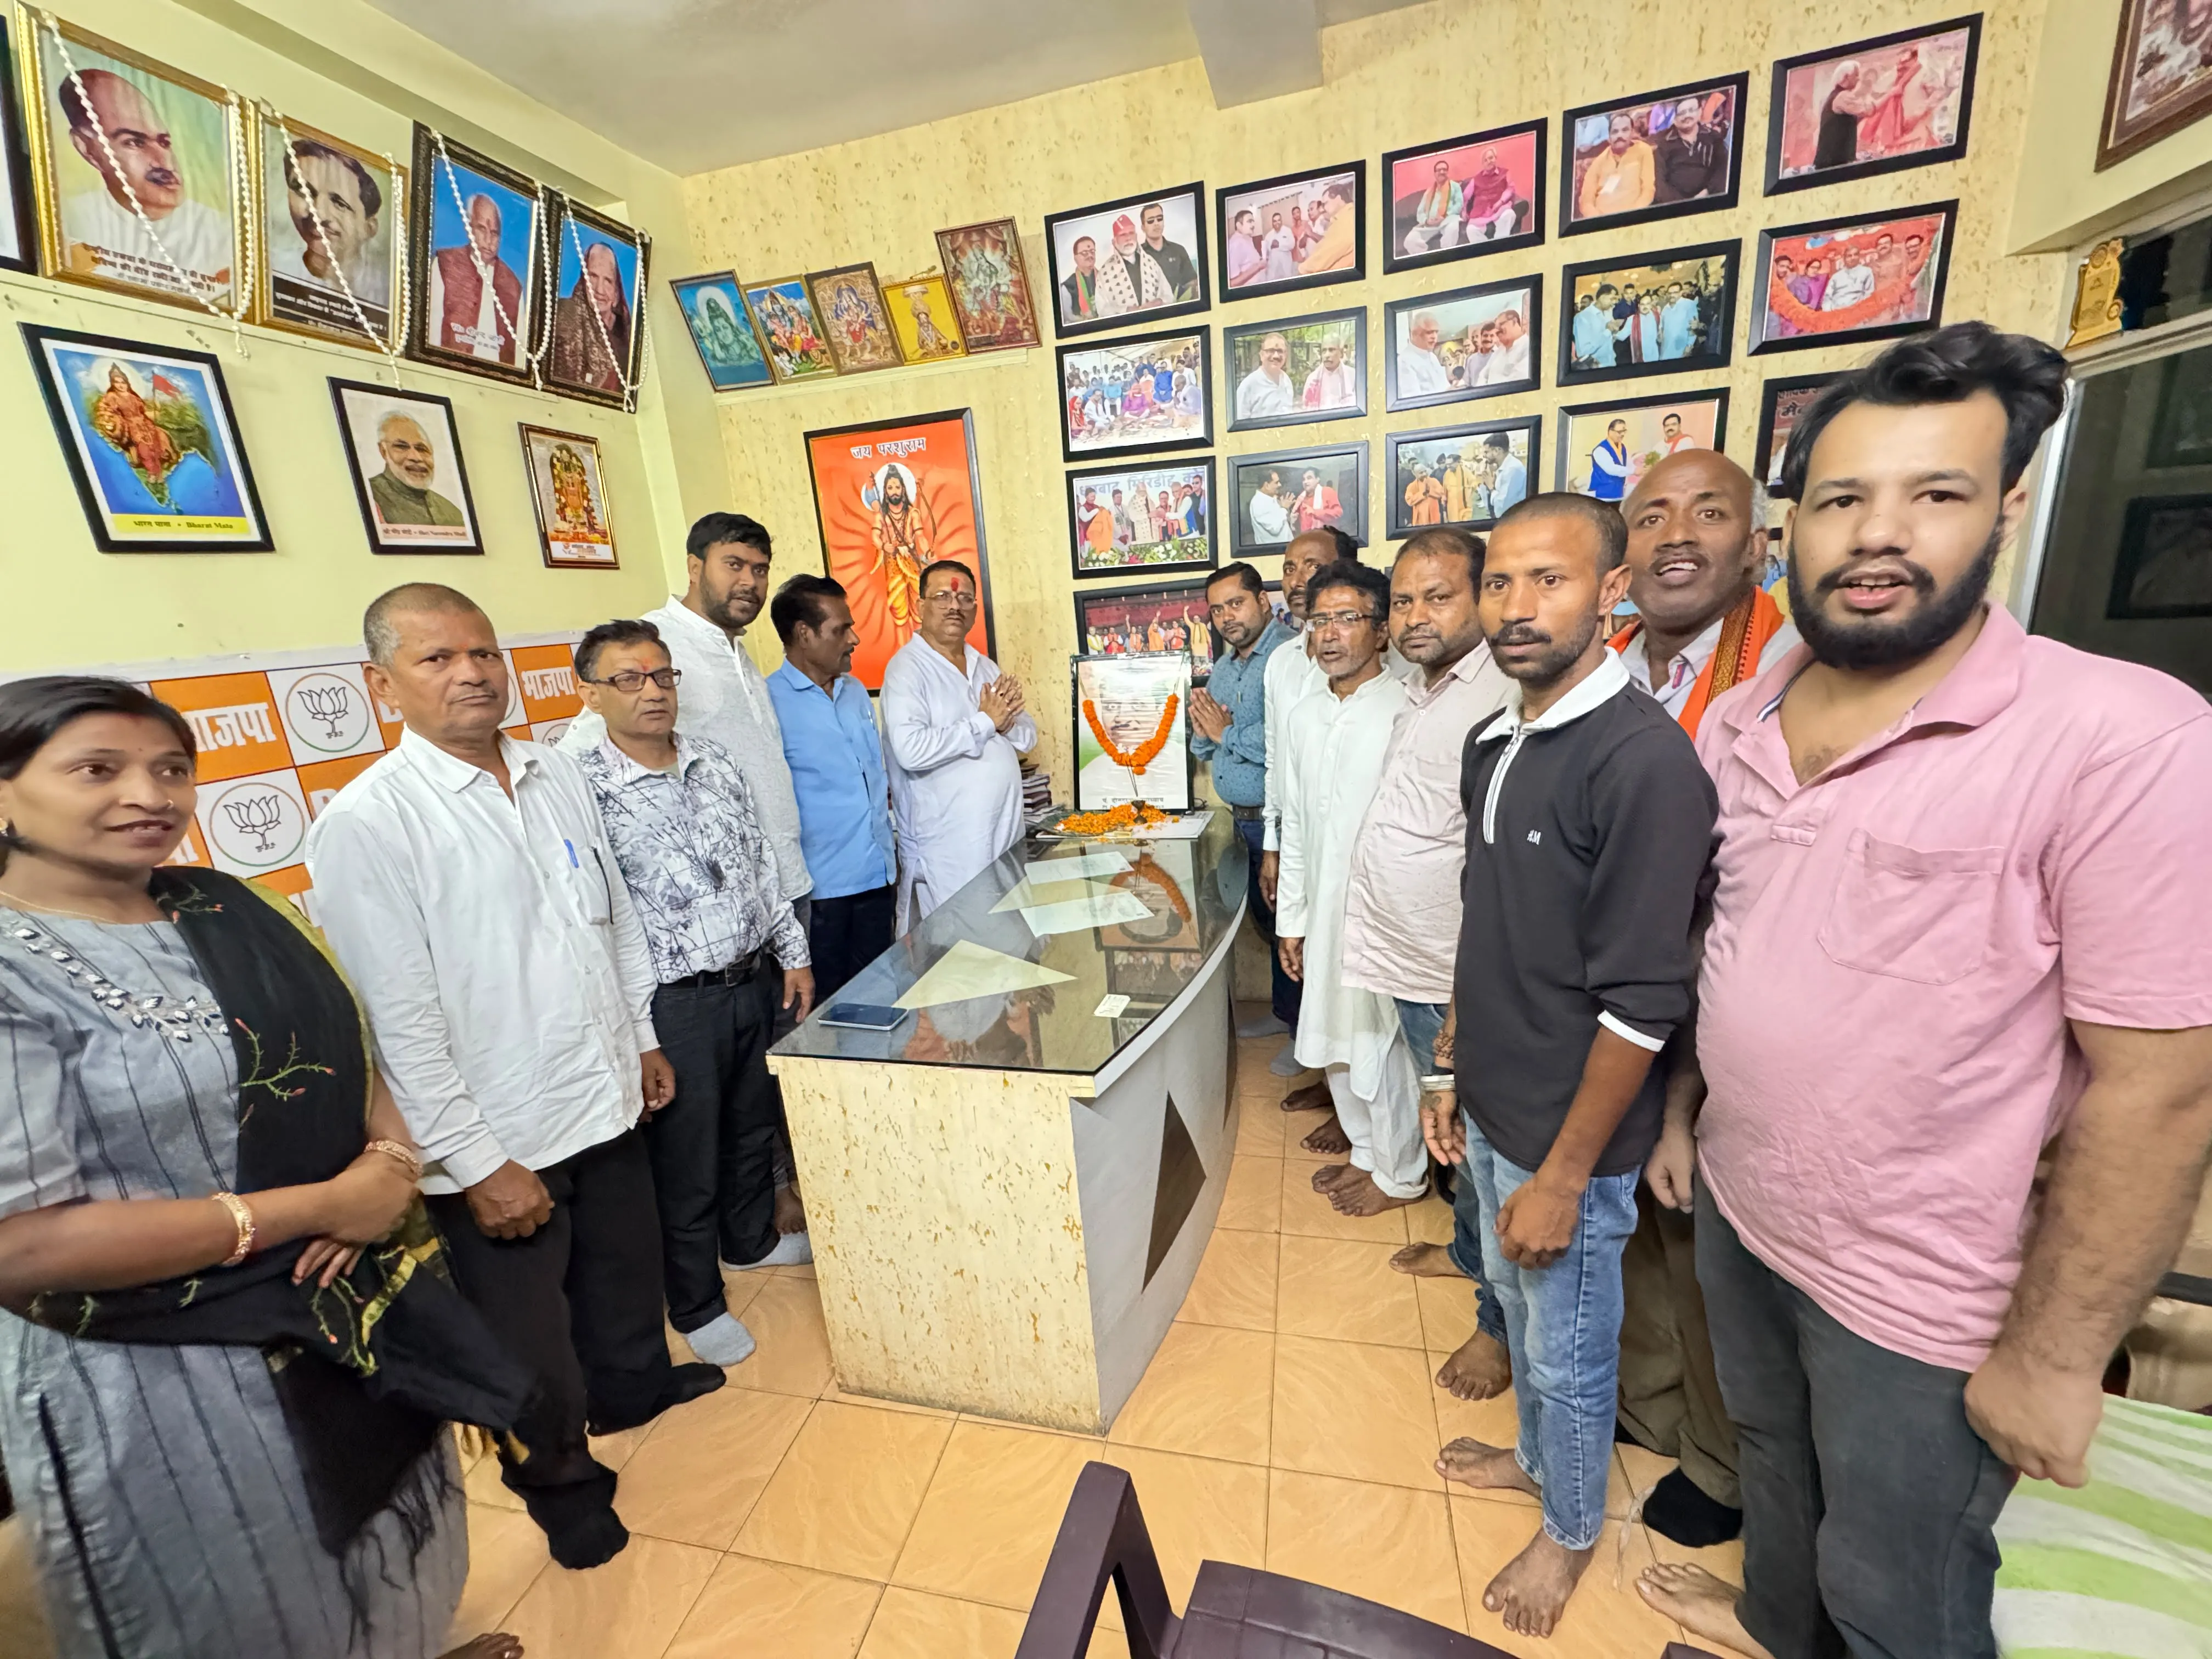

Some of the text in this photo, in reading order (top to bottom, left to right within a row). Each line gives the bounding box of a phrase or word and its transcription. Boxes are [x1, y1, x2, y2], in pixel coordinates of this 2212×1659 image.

[850, 437, 926, 459] जय परशुराम
[521, 666, 576, 701] भाजपा
